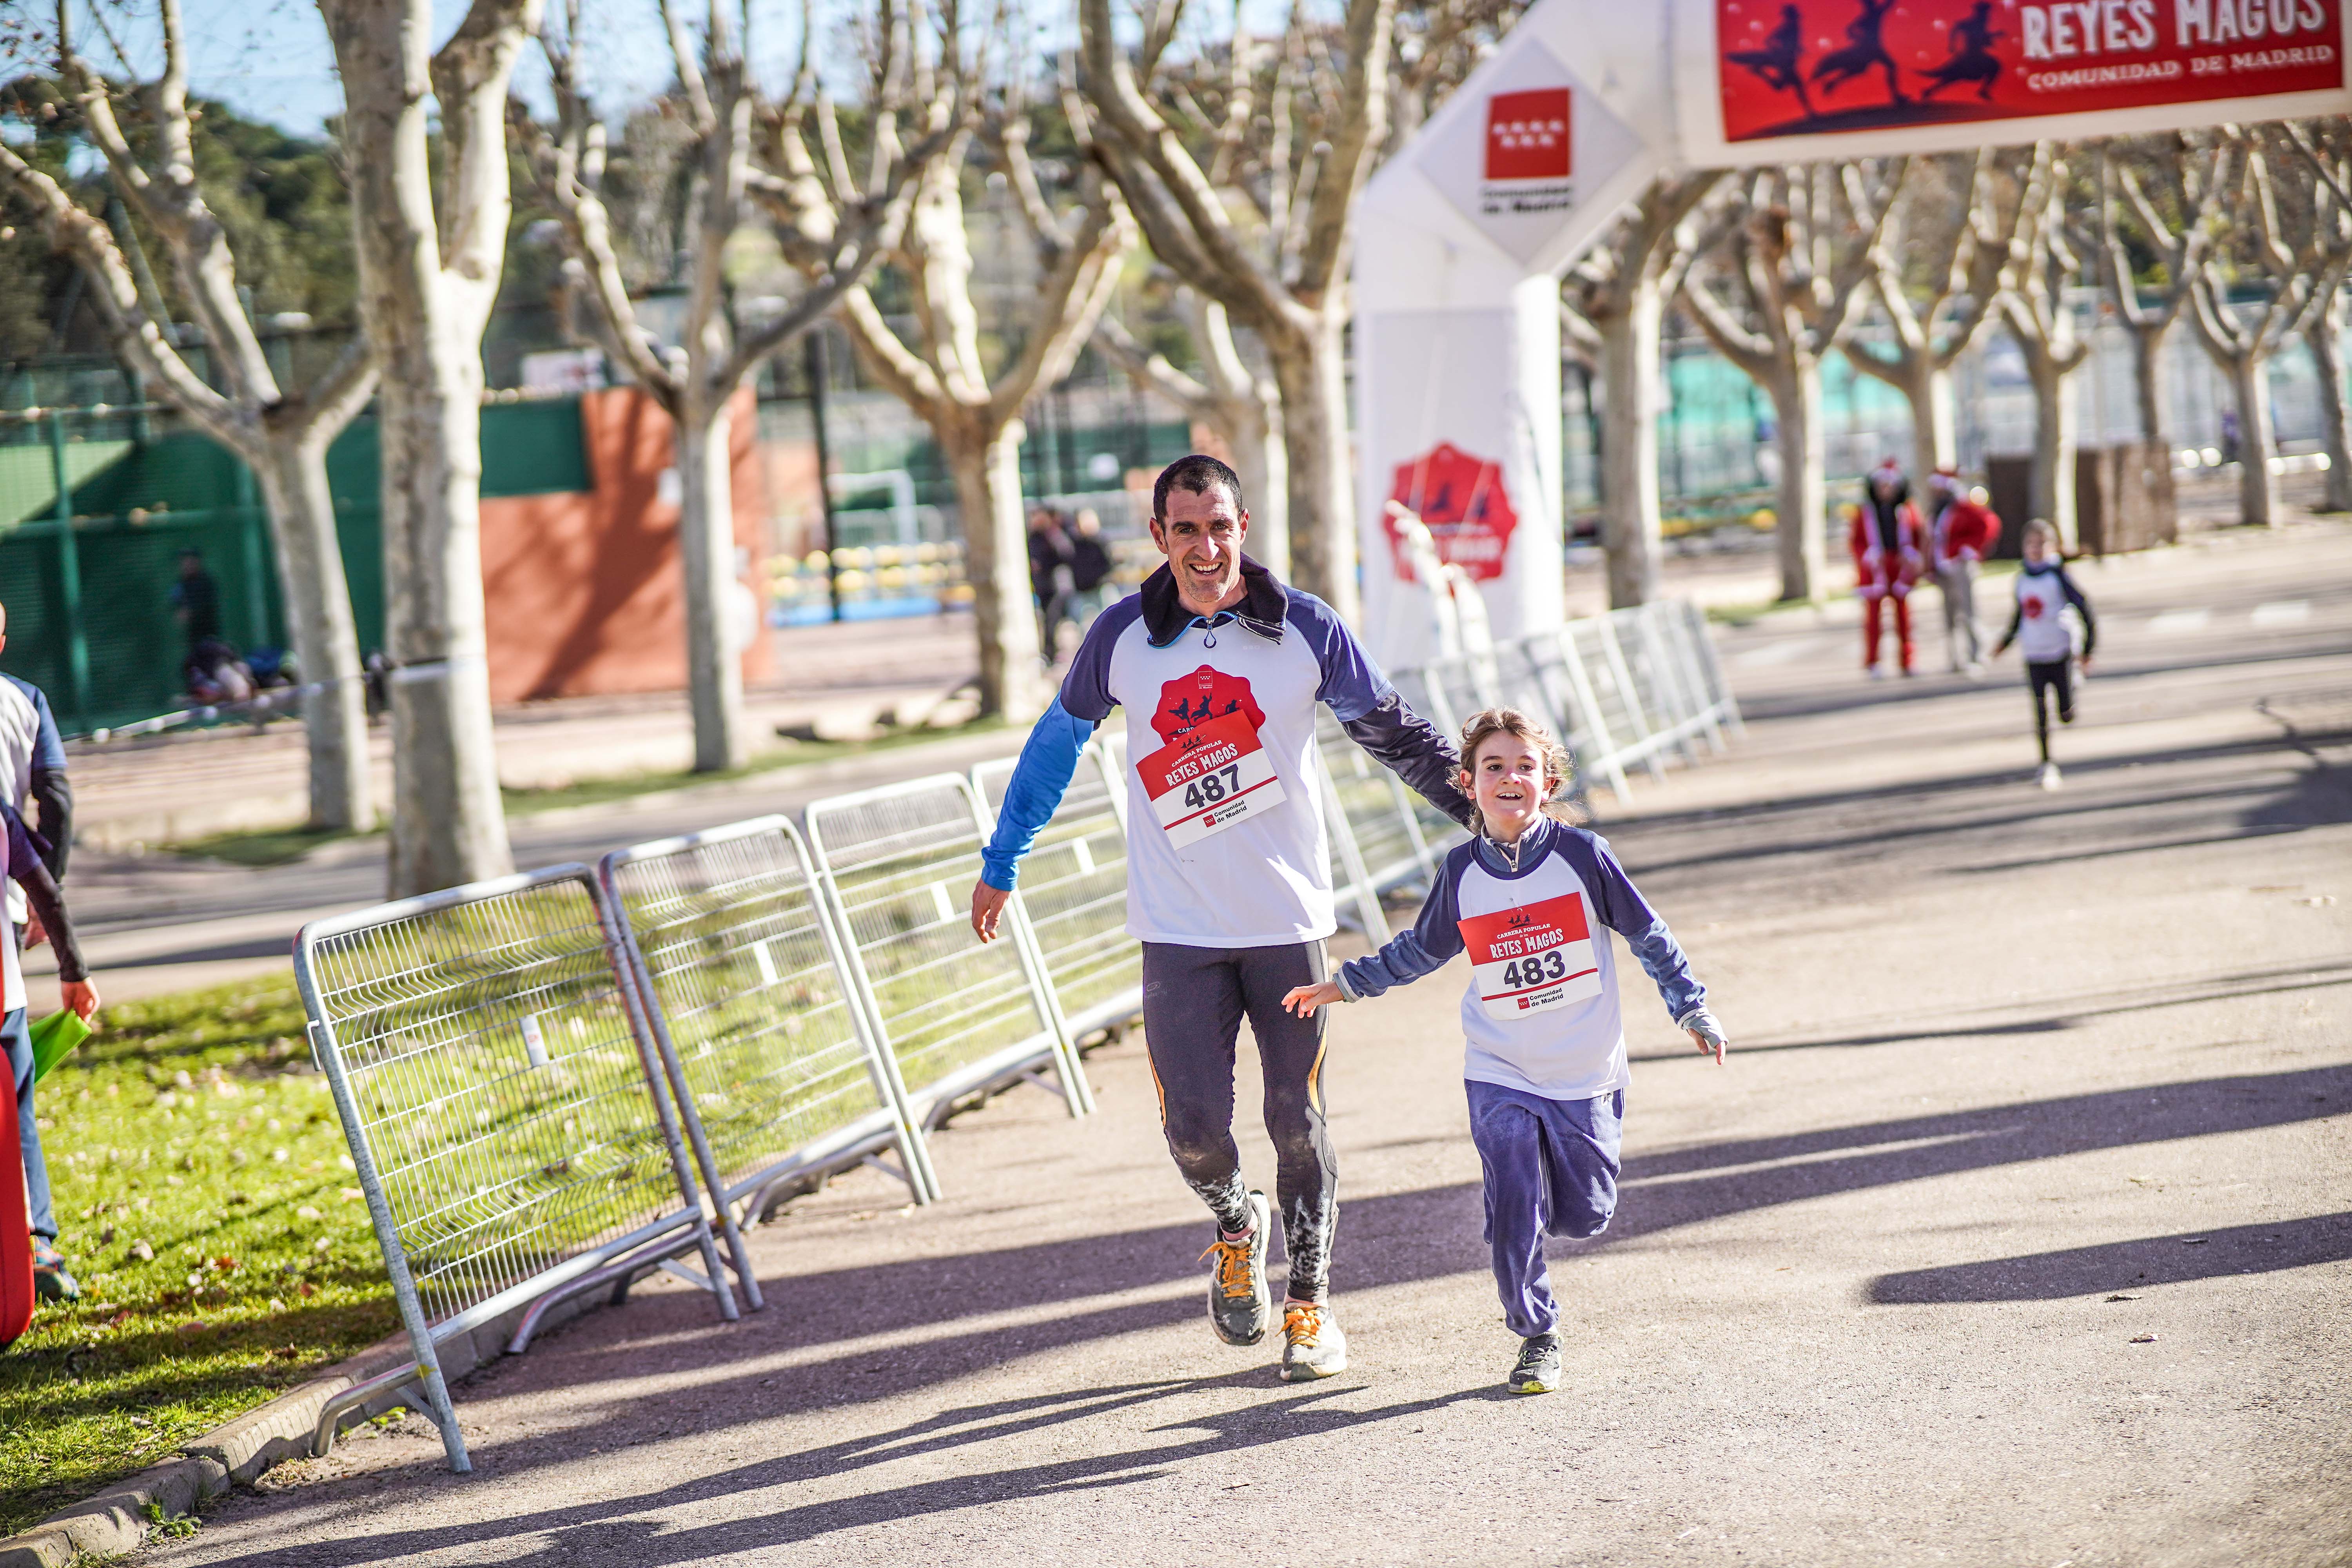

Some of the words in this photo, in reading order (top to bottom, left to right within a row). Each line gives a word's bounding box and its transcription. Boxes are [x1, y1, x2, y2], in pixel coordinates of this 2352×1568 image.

[2021, 0, 2157, 60] REYES
[2027, 61, 2180, 90] COMUNIDAD
[2190, 57, 2222, 74] DE
[2230, 45, 2334, 69] MADRID
[1165, 761, 1200, 787] REYES
[1200, 743, 1238, 771] MAGOS
[1172, 751, 1196, 767] CARRERA
[1196, 740, 1223, 753] POPULAR
[1185, 763, 1240, 808] 487
[1214, 800, 1245, 817] Comunidad
[1226, 806, 1247, 819] Madrid
[1490, 940, 1523, 958] REYES
[1525, 928, 1564, 953] MAGOS
[1497, 929, 1523, 939] CARRERA
[1523, 924, 1550, 933] POPULAR
[1504, 951, 1565, 988] 483
[1530, 987, 1562, 1000] Comunidad
[1541, 994, 1563, 1004] Madrid
